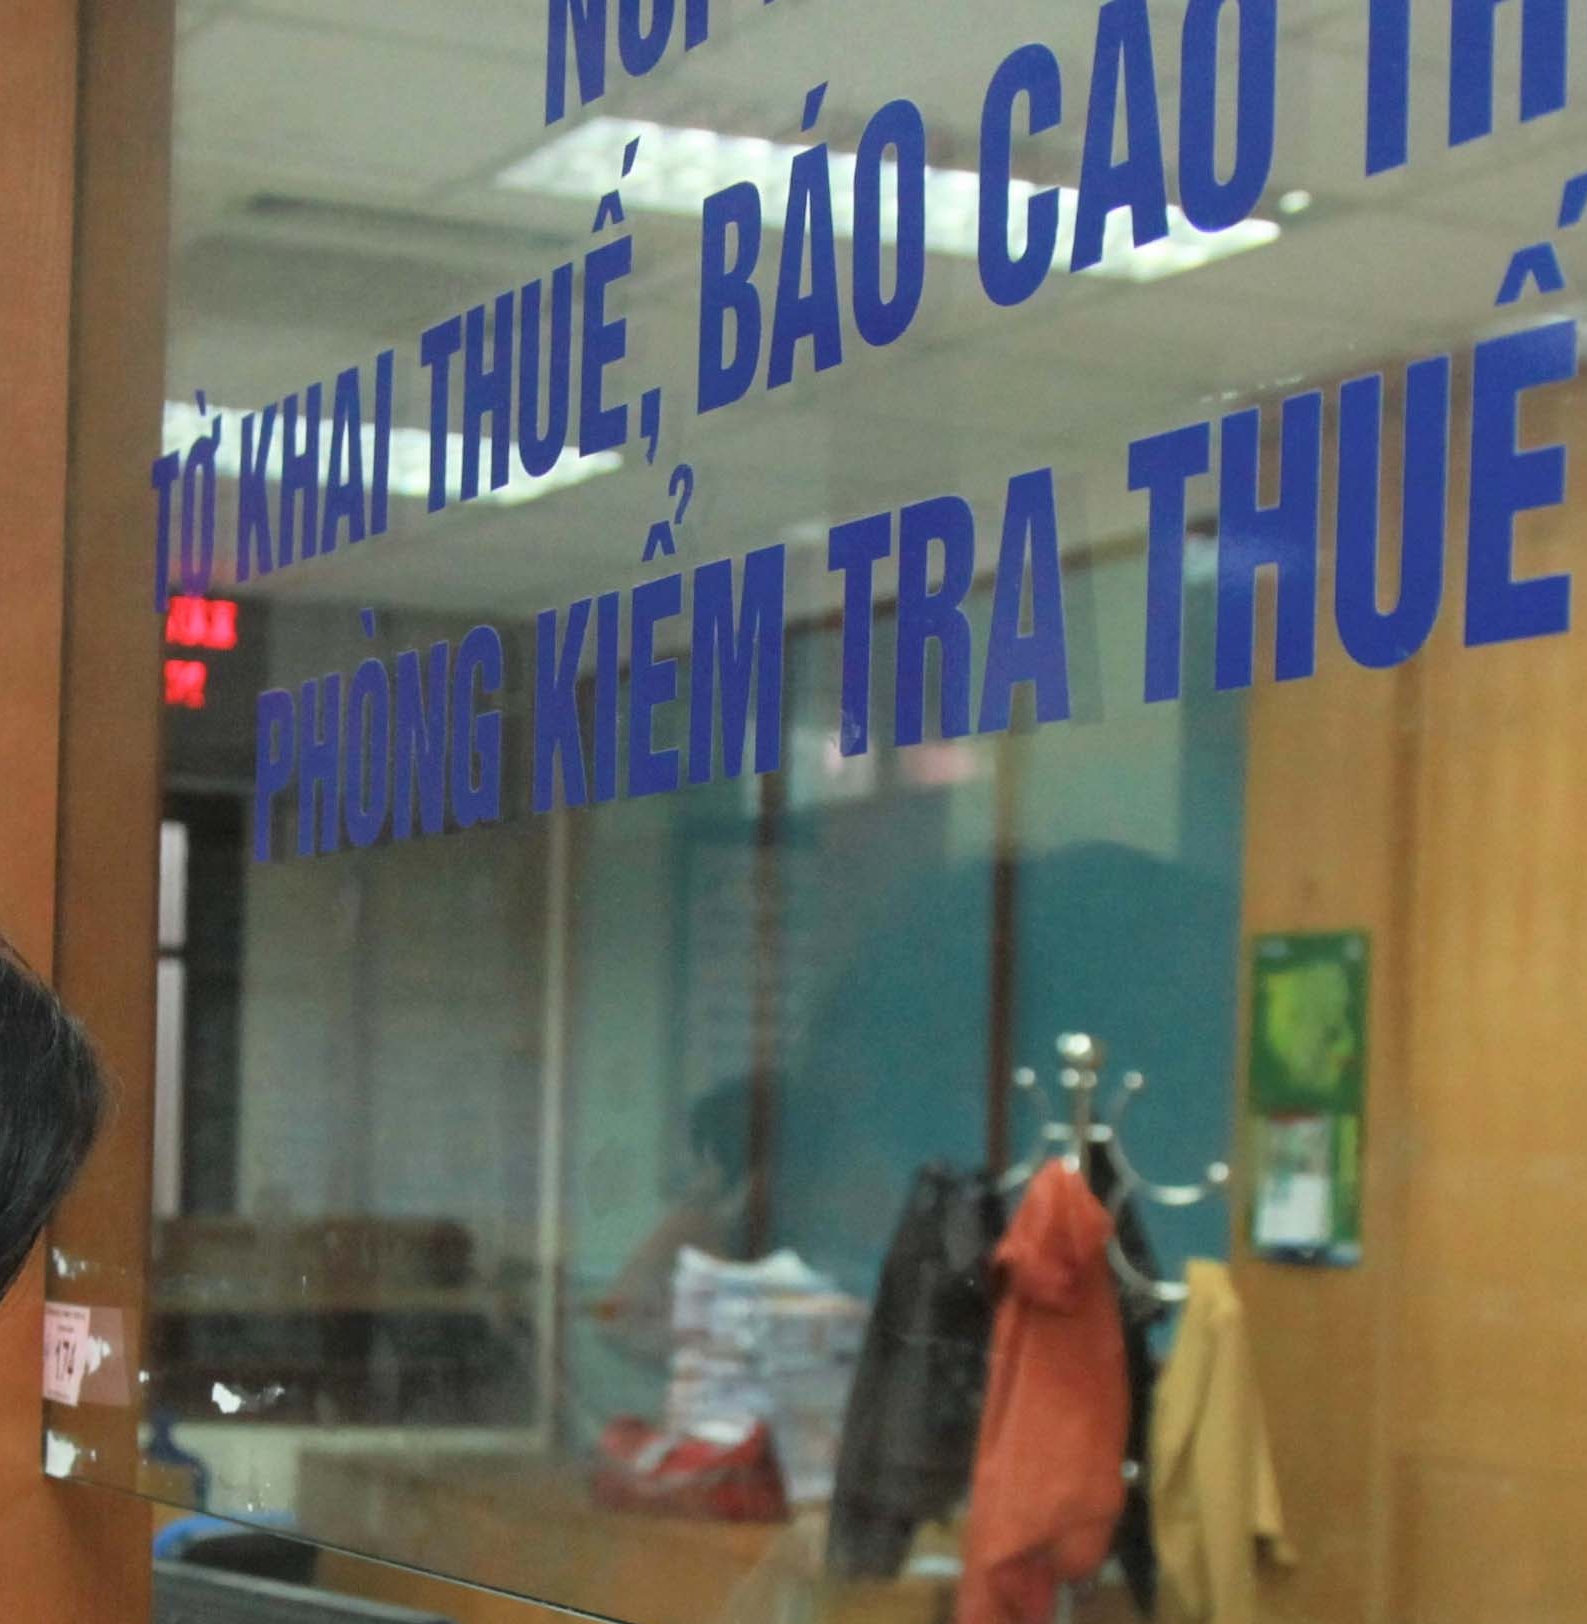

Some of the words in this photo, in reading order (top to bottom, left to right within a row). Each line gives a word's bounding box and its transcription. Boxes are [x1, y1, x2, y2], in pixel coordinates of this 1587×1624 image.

[151, 388, 222, 613] TỜ
[236, 348, 395, 584] KHAI
[420, 136, 662, 514] THUẾ,
[696, 80, 927, 416] BÁO
[252, 607, 505, 864] PHÒNG
[531, 462, 788, 813] KIỂM
[827, 465, 1071, 758] TRA
